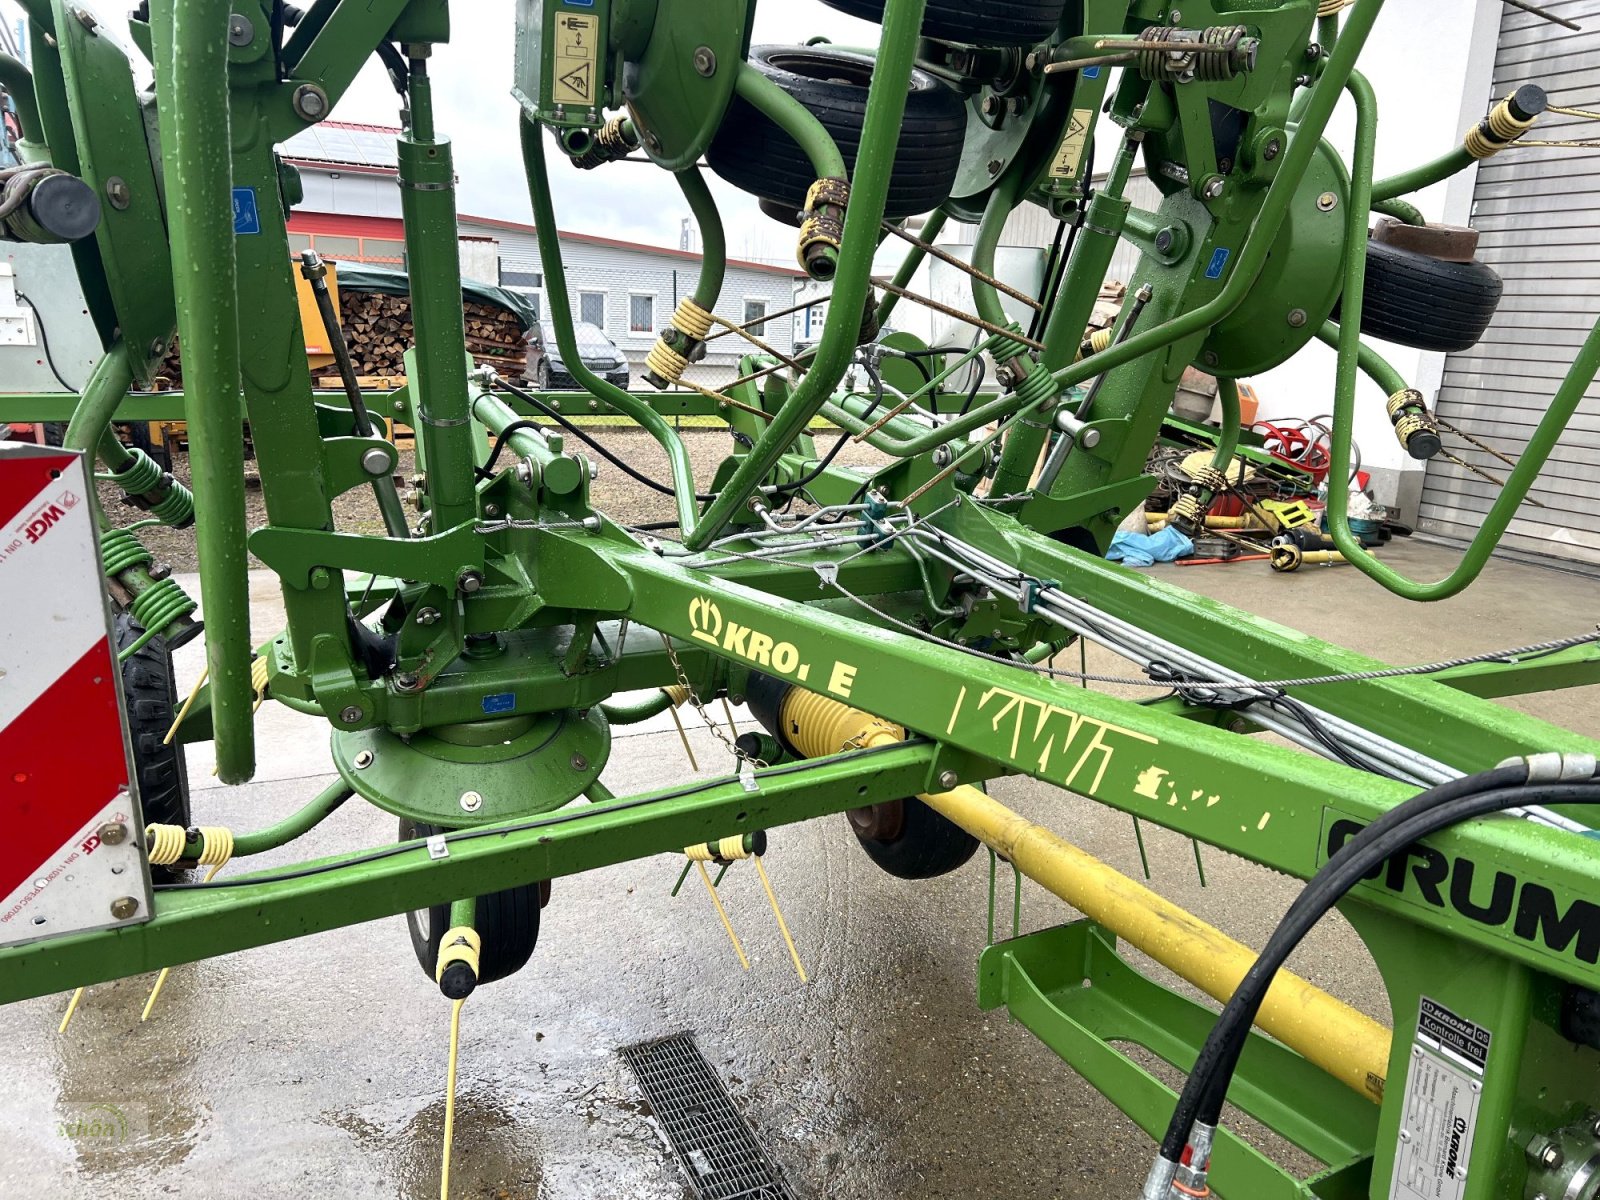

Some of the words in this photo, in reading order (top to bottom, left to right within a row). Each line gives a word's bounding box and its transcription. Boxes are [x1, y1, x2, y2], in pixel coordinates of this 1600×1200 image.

[25, 504, 66, 545] WGF
[5, 539, 22, 555] DIN
[65, 852, 79, 865] DIN
[1434, 1010, 1474, 1035] KRONE
[1477, 1021, 1489, 1043] QS
[1424, 1016, 1465, 1048] Kontrolle
[1467, 1041, 1483, 1058] frei
[1446, 1129, 1462, 1180] KRONE
